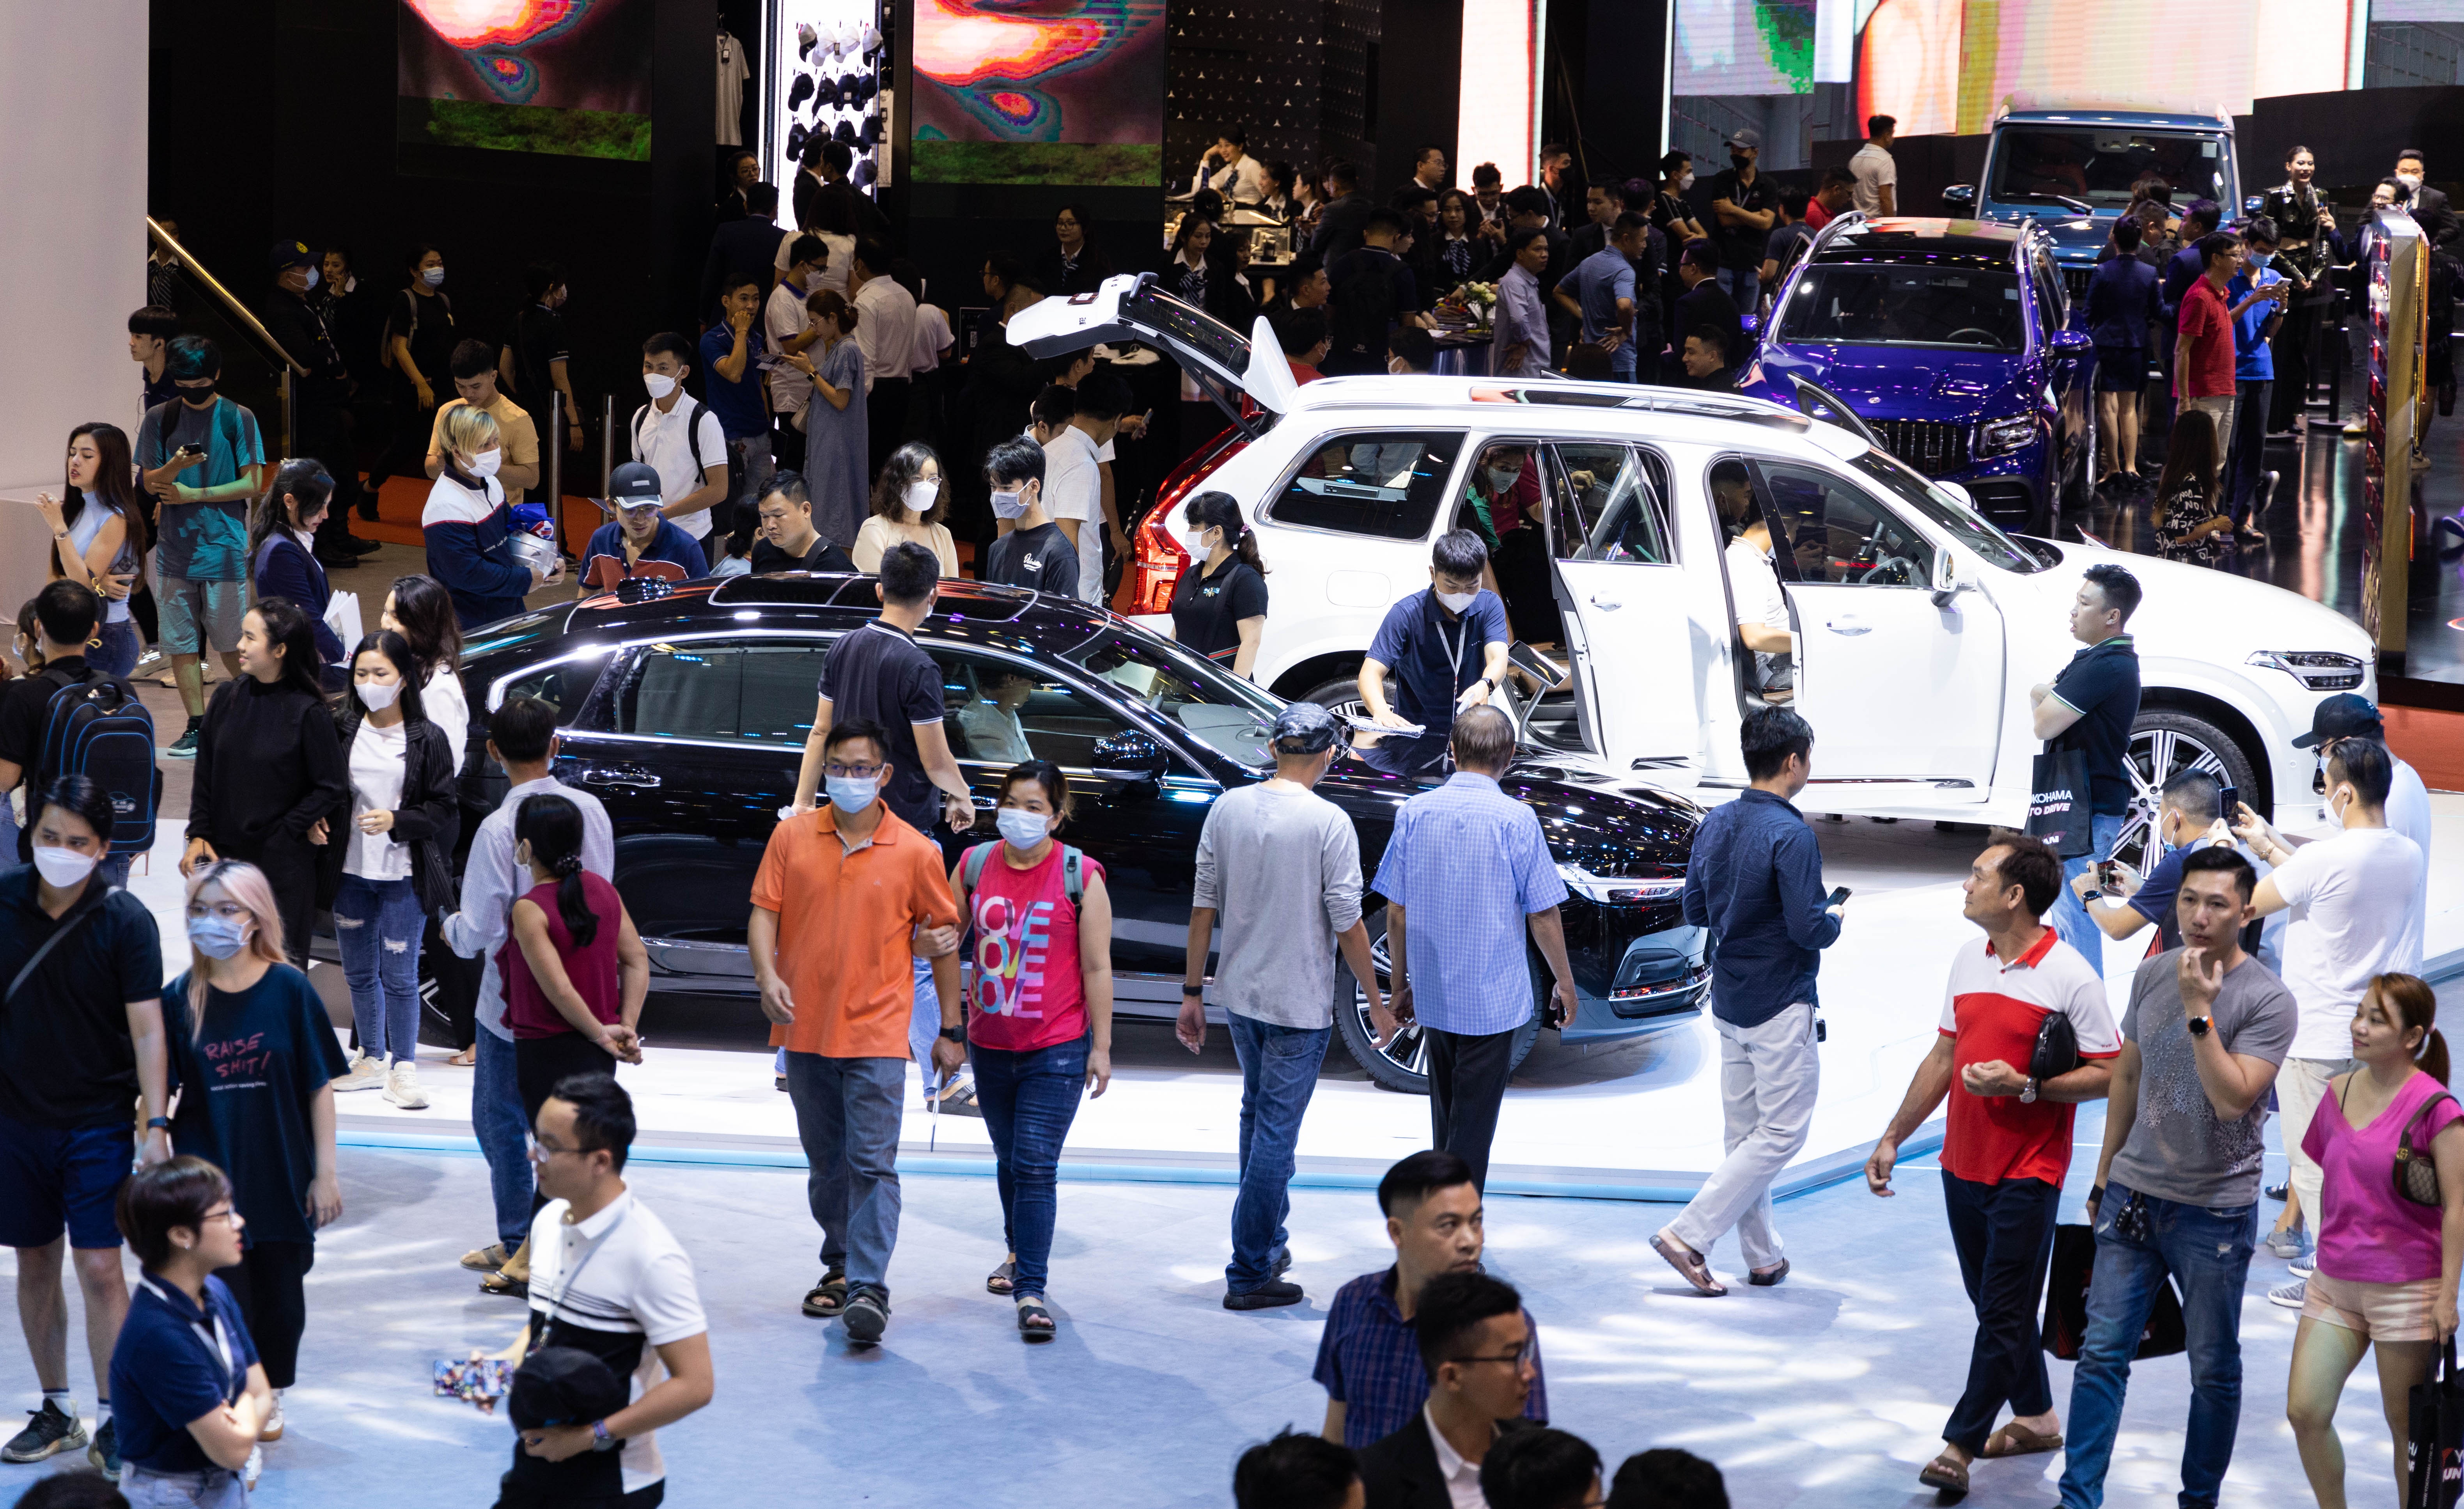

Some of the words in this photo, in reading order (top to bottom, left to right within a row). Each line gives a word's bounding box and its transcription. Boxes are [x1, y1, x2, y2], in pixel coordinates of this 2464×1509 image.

[2043, 803, 2071, 815] DRIVE
[972, 894, 1054, 942] LOVE
[972, 936, 1049, 980] LOVE
[971, 967, 1044, 1018] LOVE
[203, 1032, 265, 1061] RAISE
[215, 1050, 272, 1078] SHIT!
